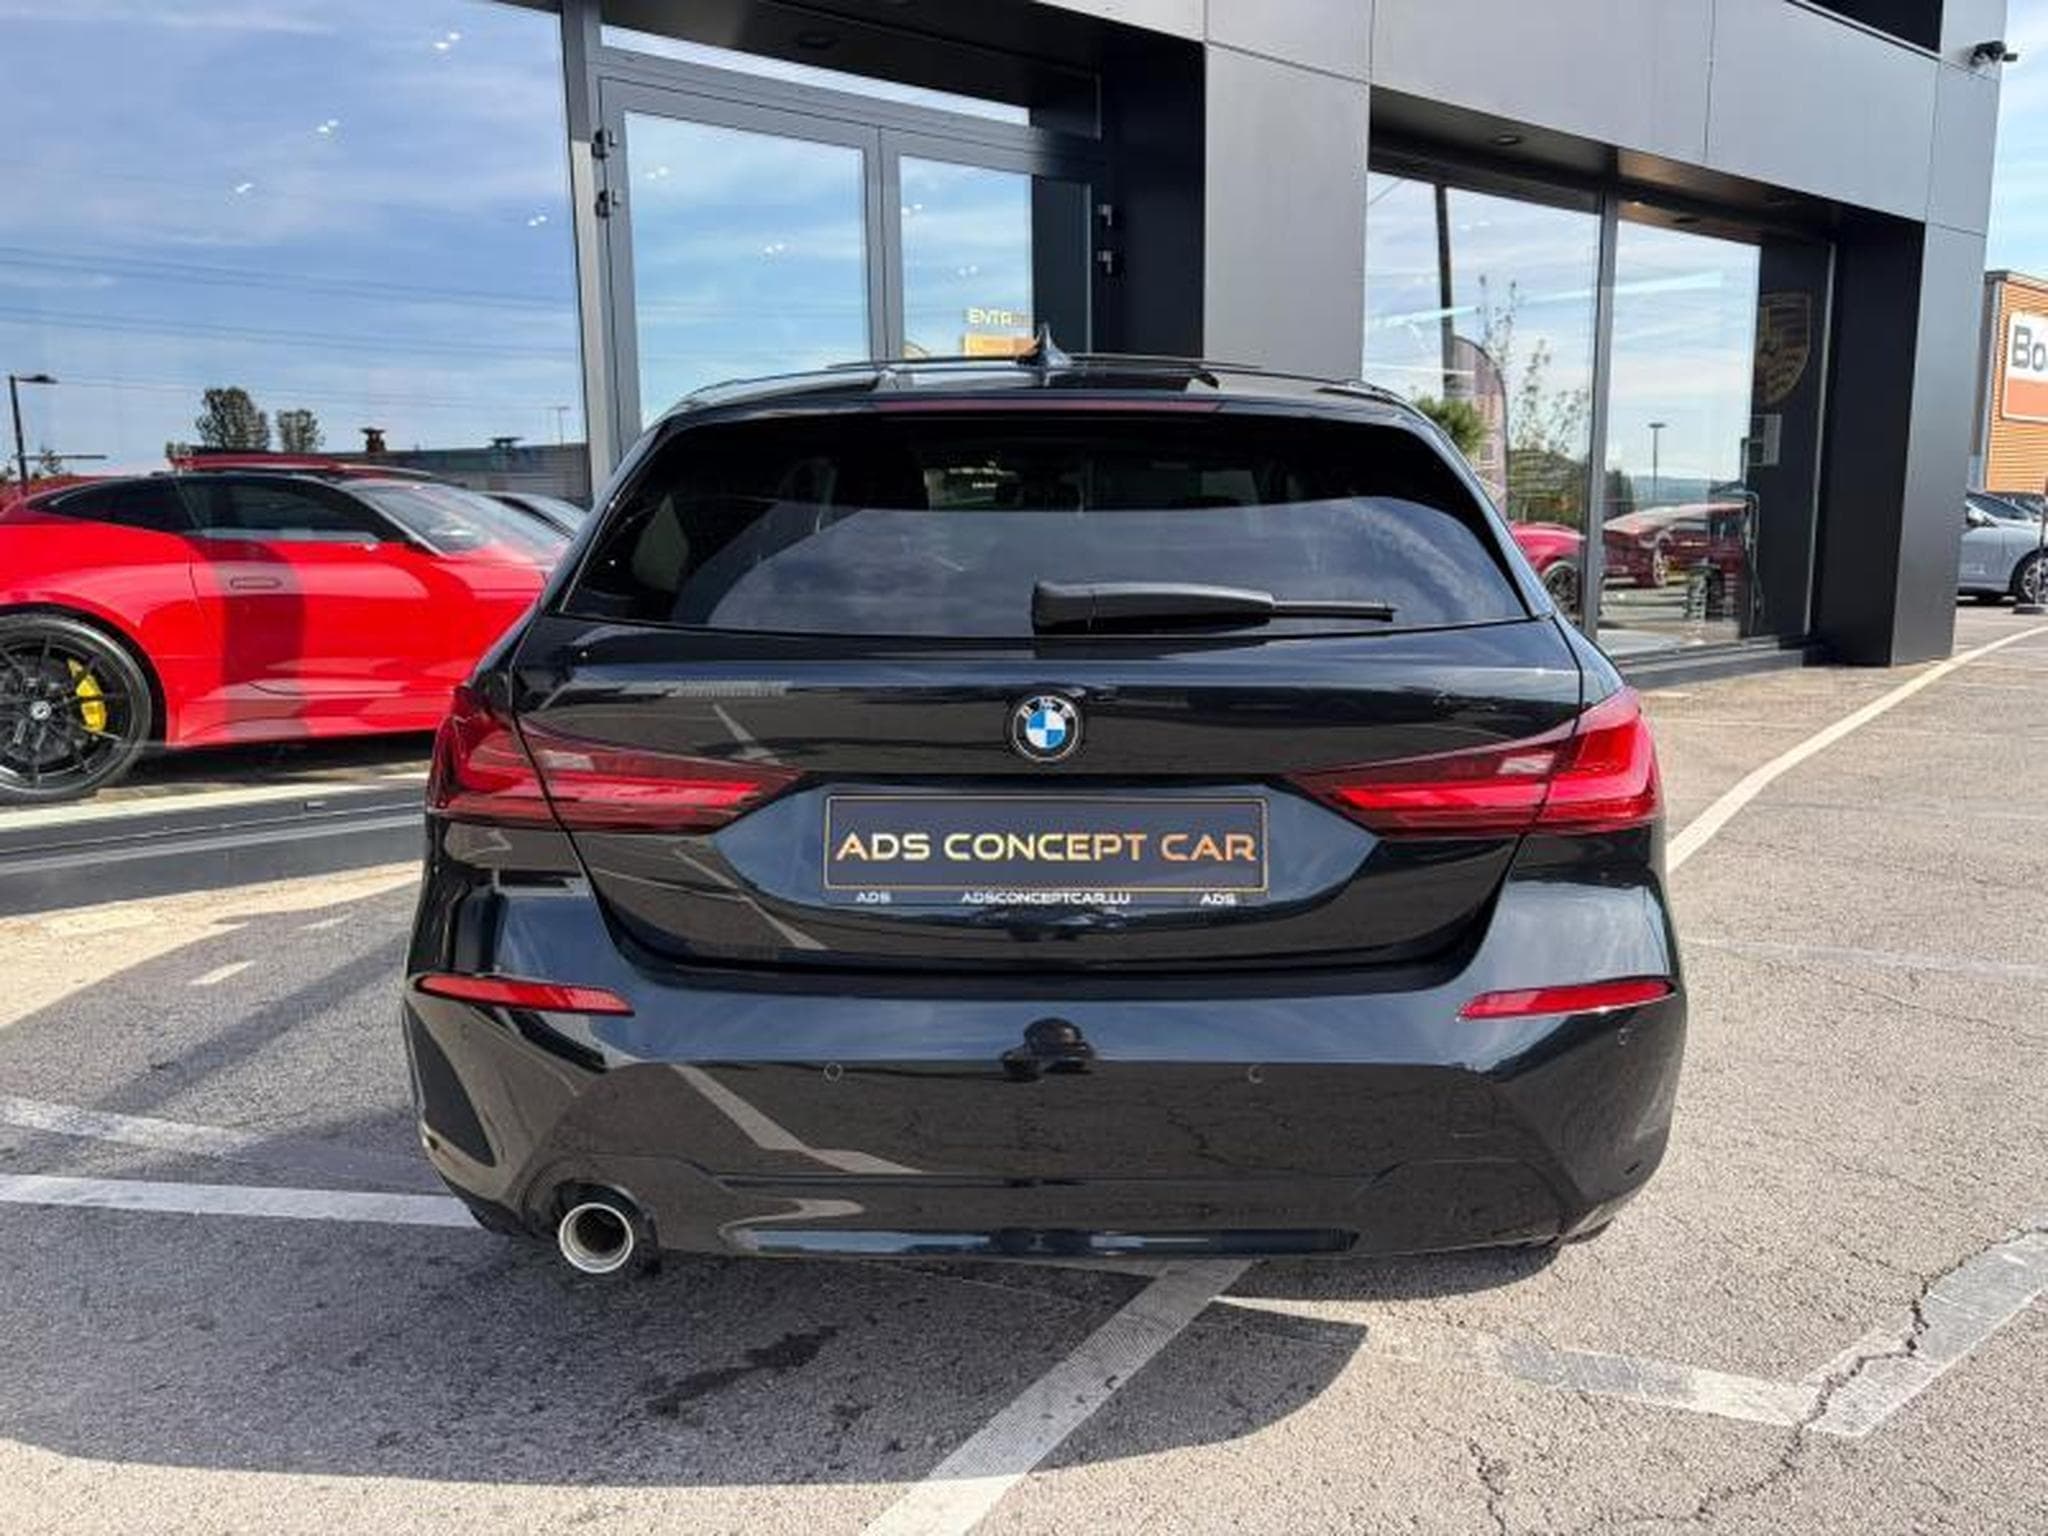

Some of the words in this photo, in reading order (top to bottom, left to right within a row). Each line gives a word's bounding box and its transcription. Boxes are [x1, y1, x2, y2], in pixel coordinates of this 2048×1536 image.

[836, 832, 931, 861] ADS
[944, 832, 1148, 861] CONCEPT
[1160, 833, 1258, 862] CAR
[855, 891, 892, 904] ADS
